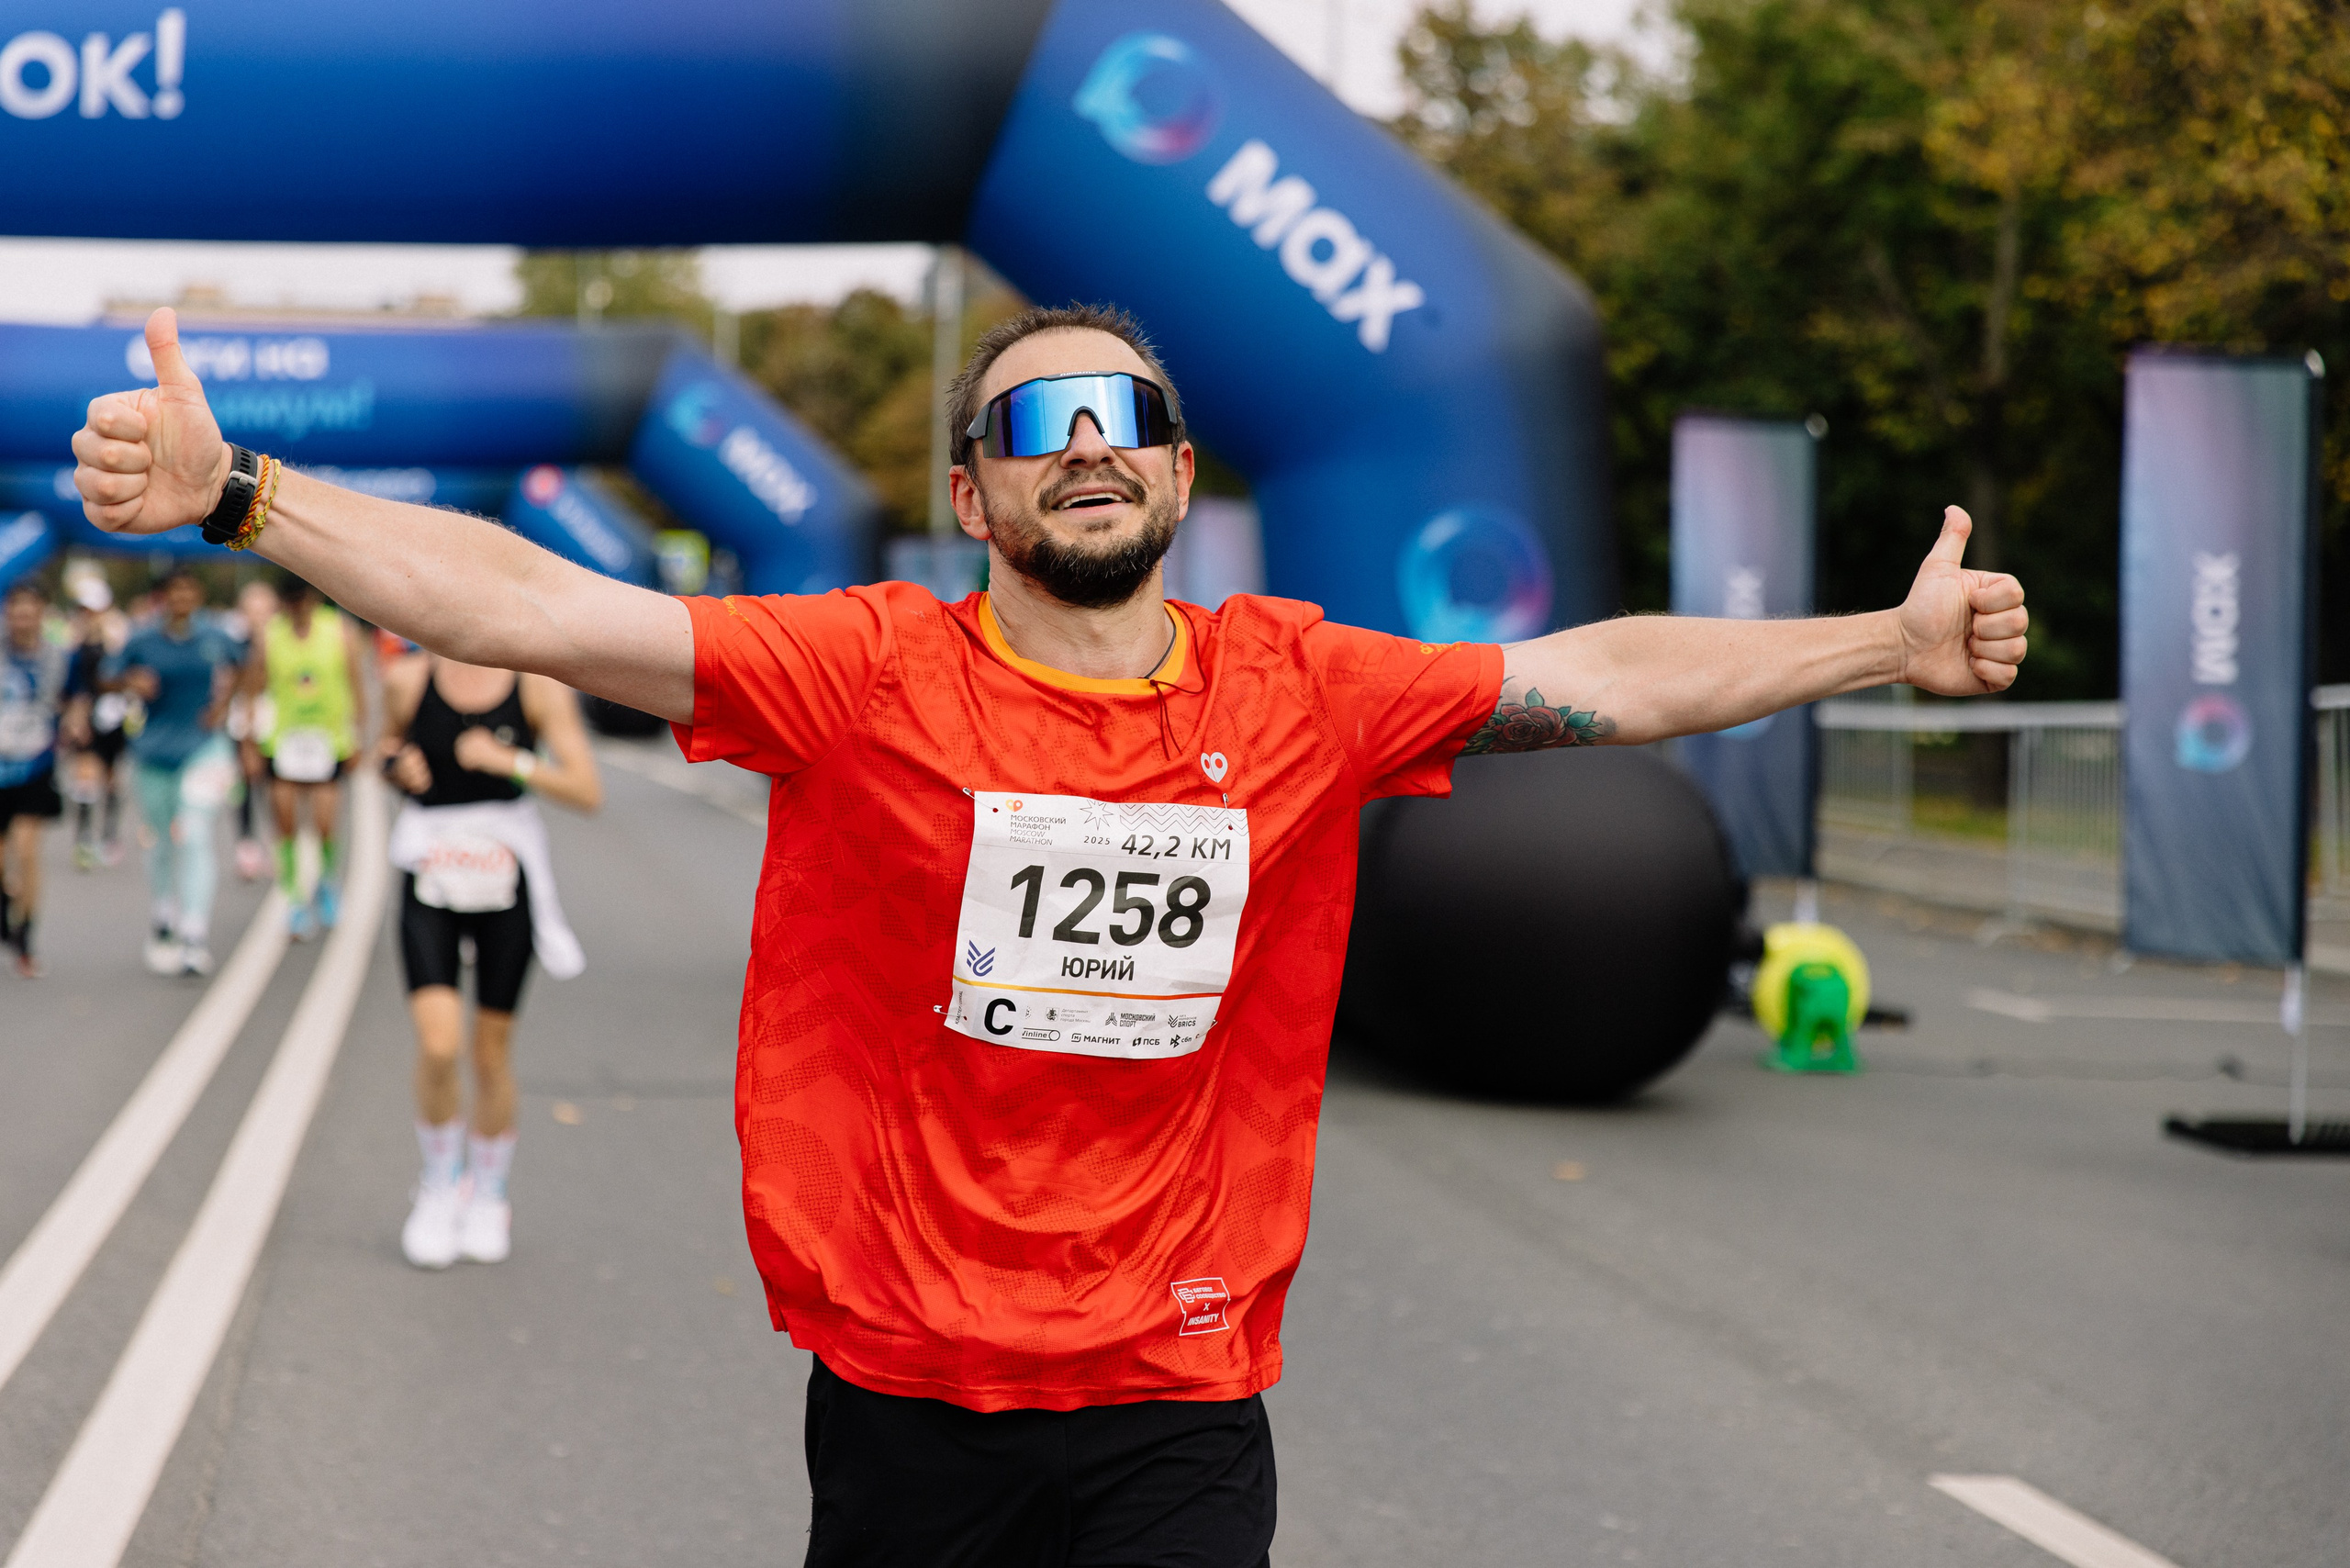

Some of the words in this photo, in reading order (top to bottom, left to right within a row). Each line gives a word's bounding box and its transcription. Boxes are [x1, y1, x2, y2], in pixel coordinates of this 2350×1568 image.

[1011, 814, 1067, 824] МОСКОВСКИЙ
[1010, 822, 1051, 831] МАРАФОН
[1010, 829, 1046, 837] MOSCOW
[1009, 835, 1053, 846] MARATHON
[1083, 835, 1111, 845] 2025
[1121, 834, 1181, 859] 42,2
[1010, 865, 1212, 948] 1258
[1061, 956, 1135, 981] ЮРИЙ
[1120, 1013, 1156, 1021] МОСКОВСКИЙ
[1083, 1036, 1121, 1045] МАГНИТ
[1187, 1313, 1220, 1326] INSANITY
